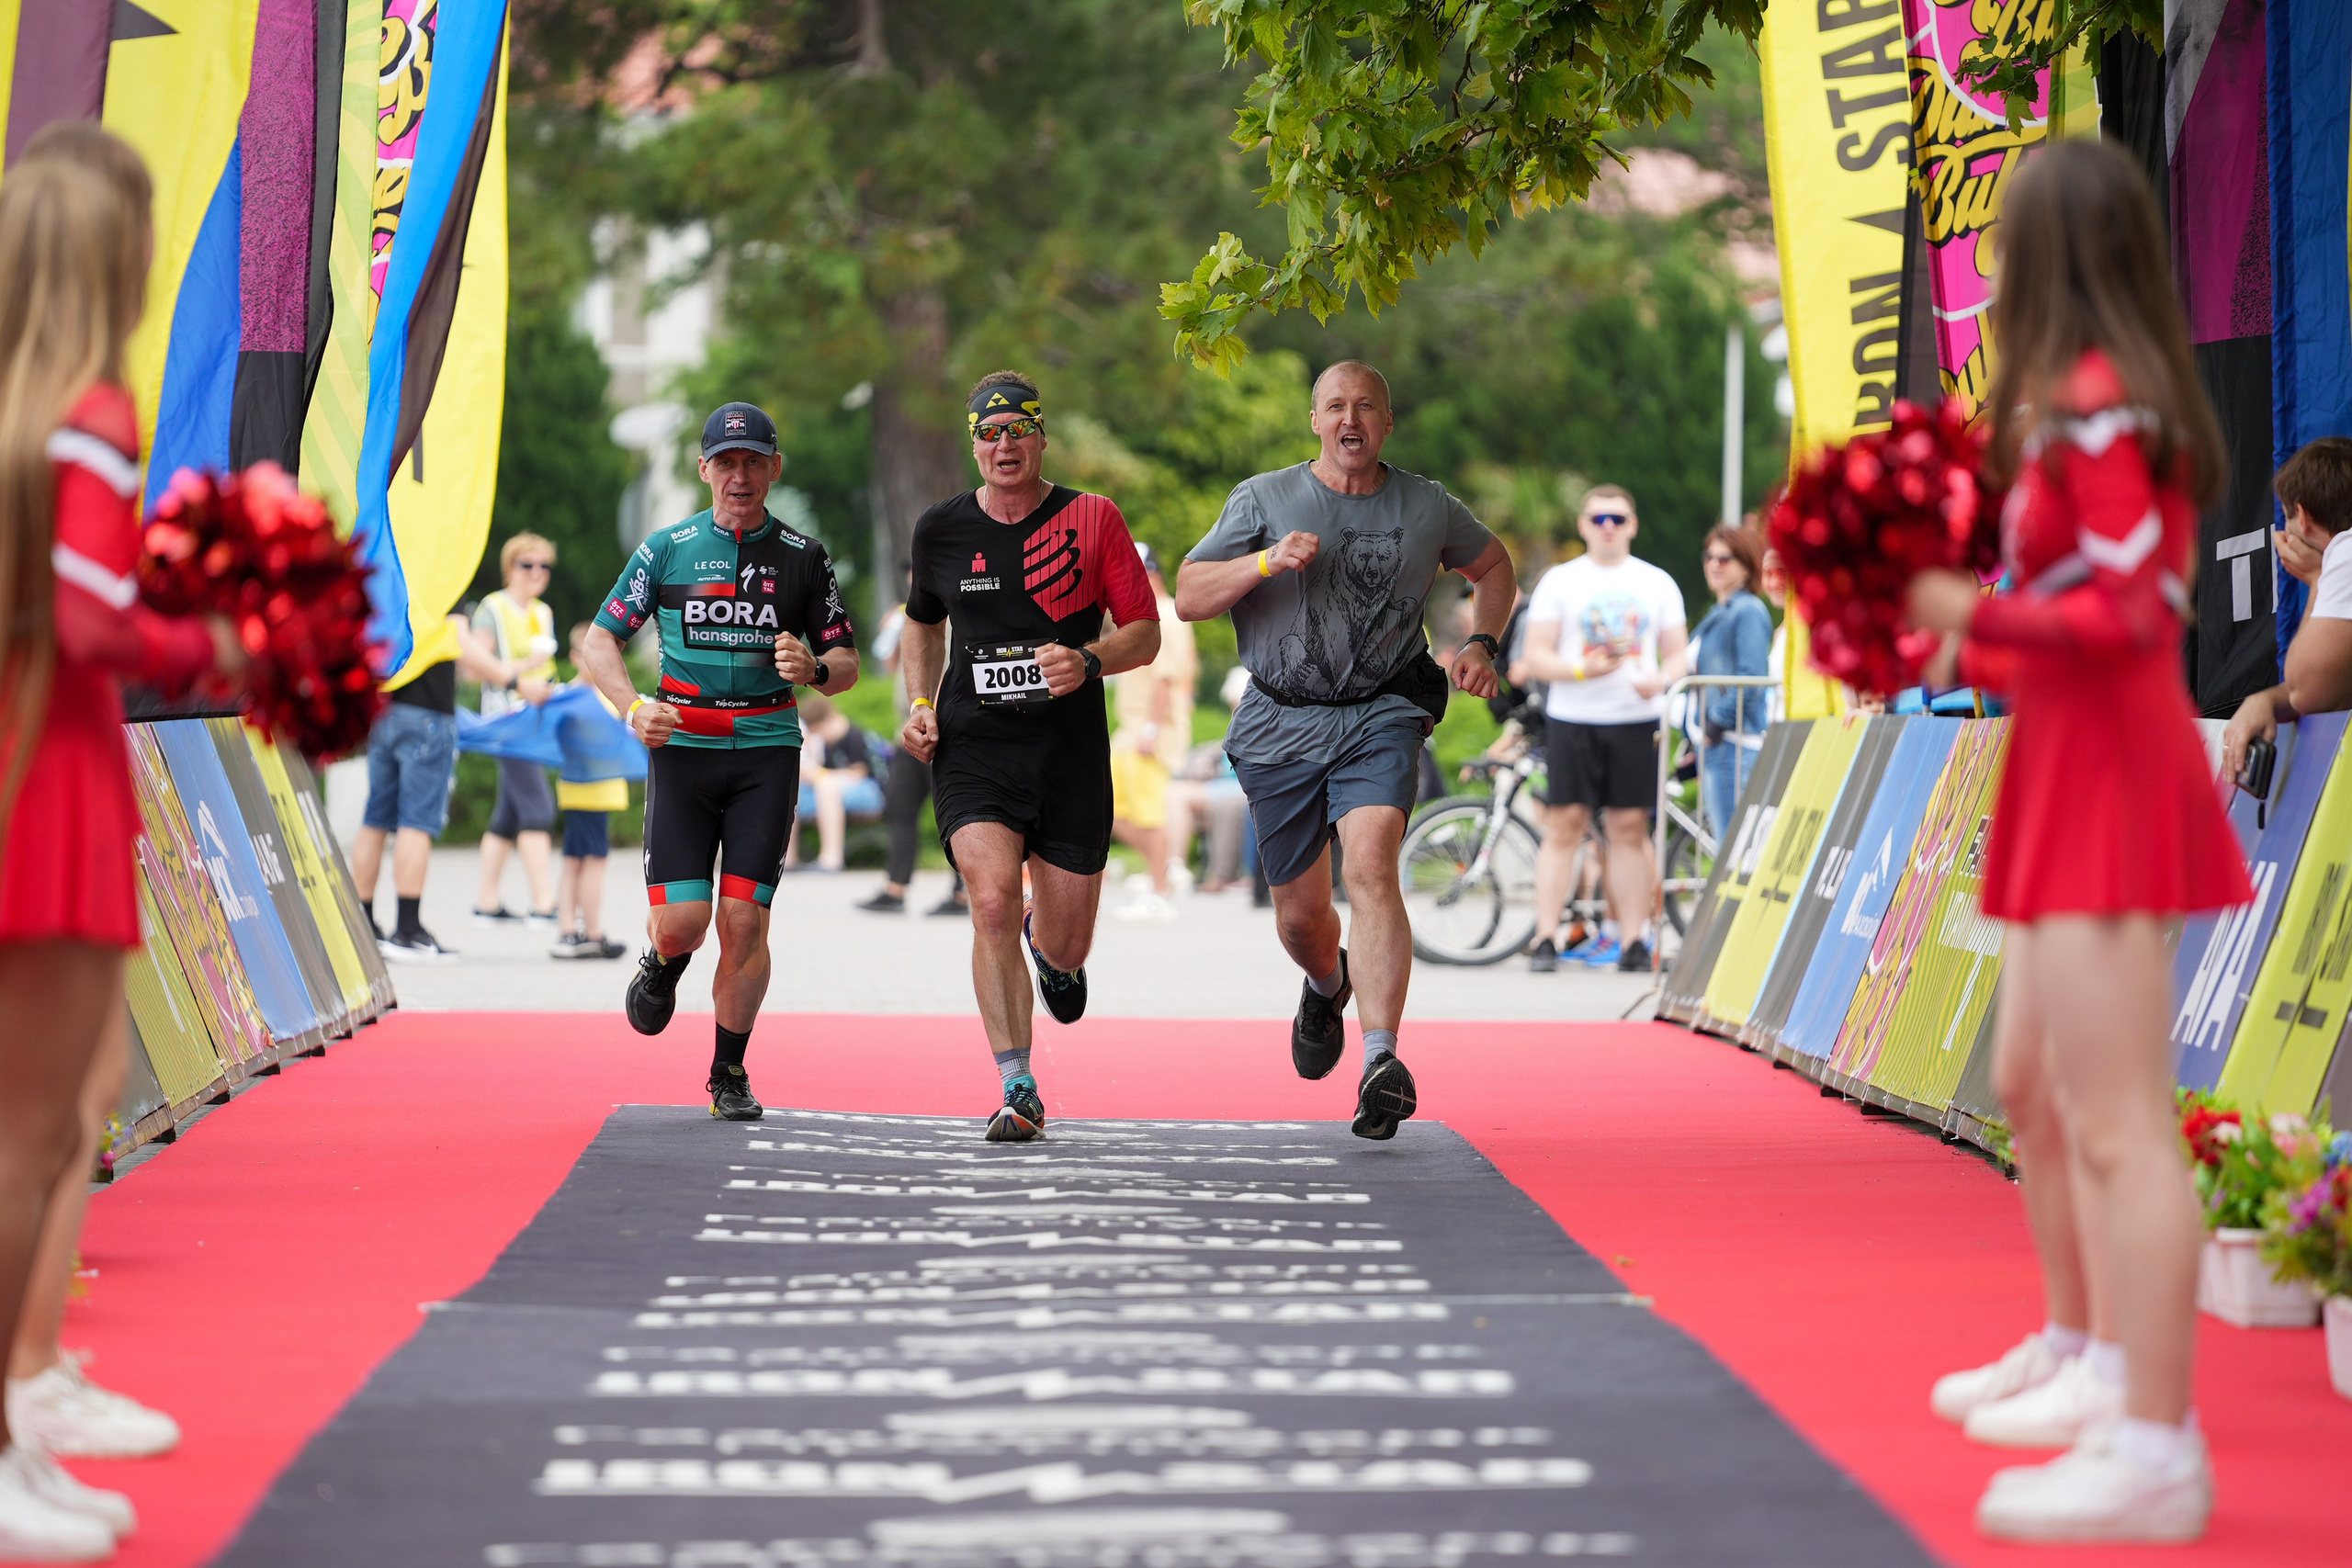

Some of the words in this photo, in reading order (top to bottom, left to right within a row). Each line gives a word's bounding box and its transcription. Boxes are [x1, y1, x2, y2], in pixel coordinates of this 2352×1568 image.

[670, 525, 698, 540] BORA
[713, 525, 729, 536] BORA
[780, 529, 807, 545] BORA
[695, 561, 707, 570] LE
[709, 560, 731, 570] COL
[960, 578, 992, 586] ANYTHING
[960, 582, 1001, 592] POSSIBLE
[684, 601, 779, 628] BORA
[689, 626, 775, 646] hansgrohe
[984, 664, 1042, 689] 2008
[1001, 693, 1027, 701] MIKHAIL
